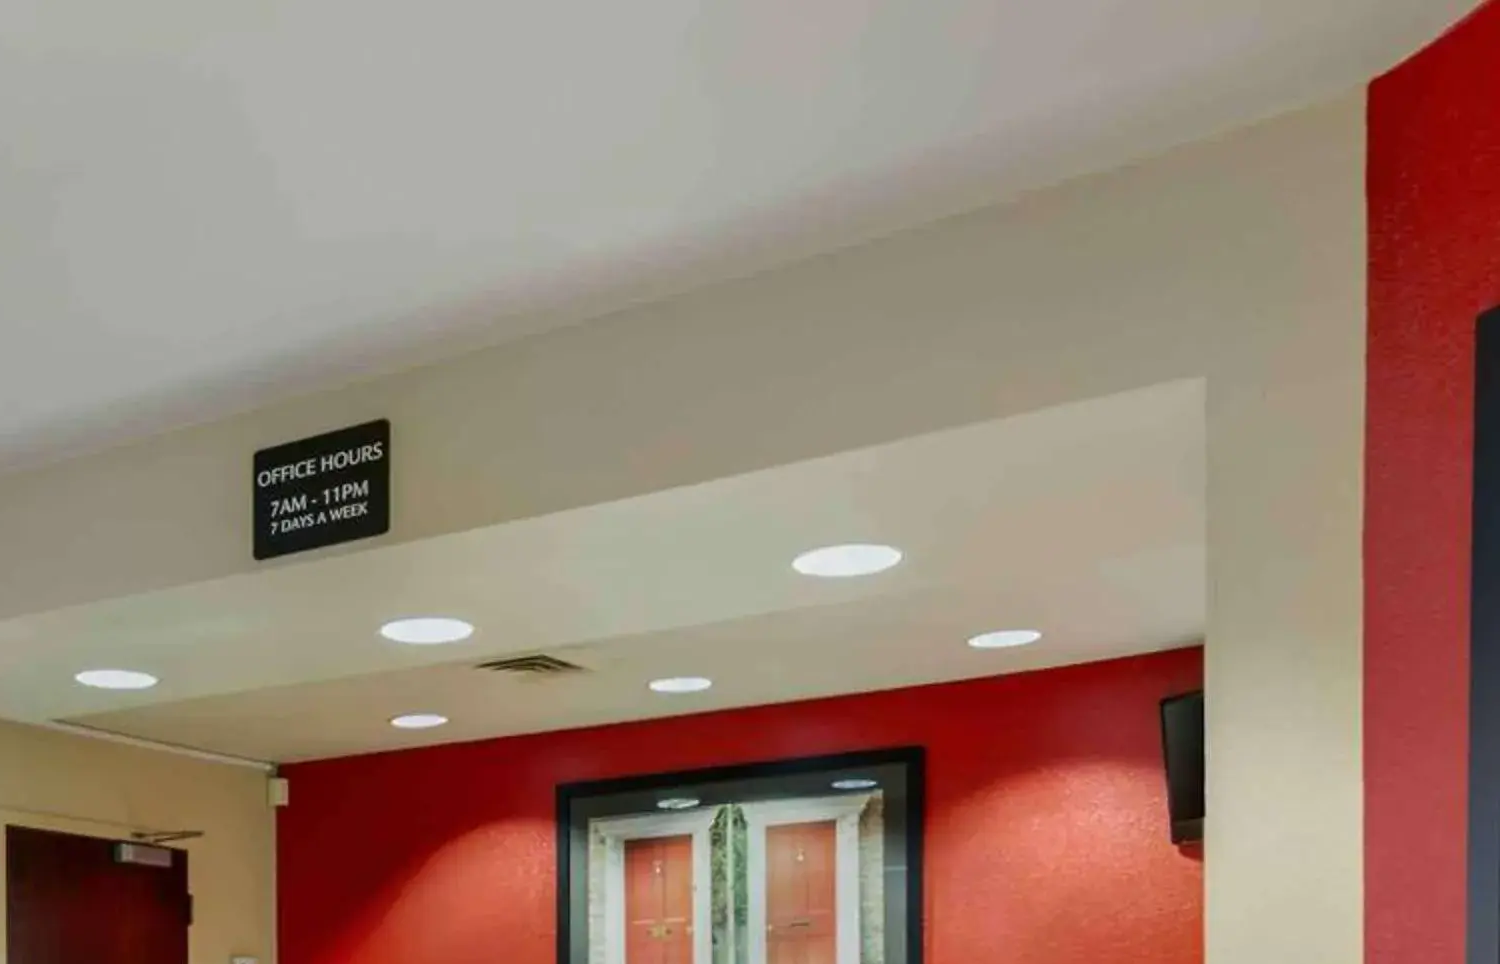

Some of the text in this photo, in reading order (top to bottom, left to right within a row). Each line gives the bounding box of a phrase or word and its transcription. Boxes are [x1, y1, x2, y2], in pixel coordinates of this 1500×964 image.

[257, 441, 383, 487] OFFICE HOURS
[270, 494, 307, 518] 7AM
[323, 480, 369, 505] 11PM
[270, 502, 368, 535] 7 DAYS A WEEK
